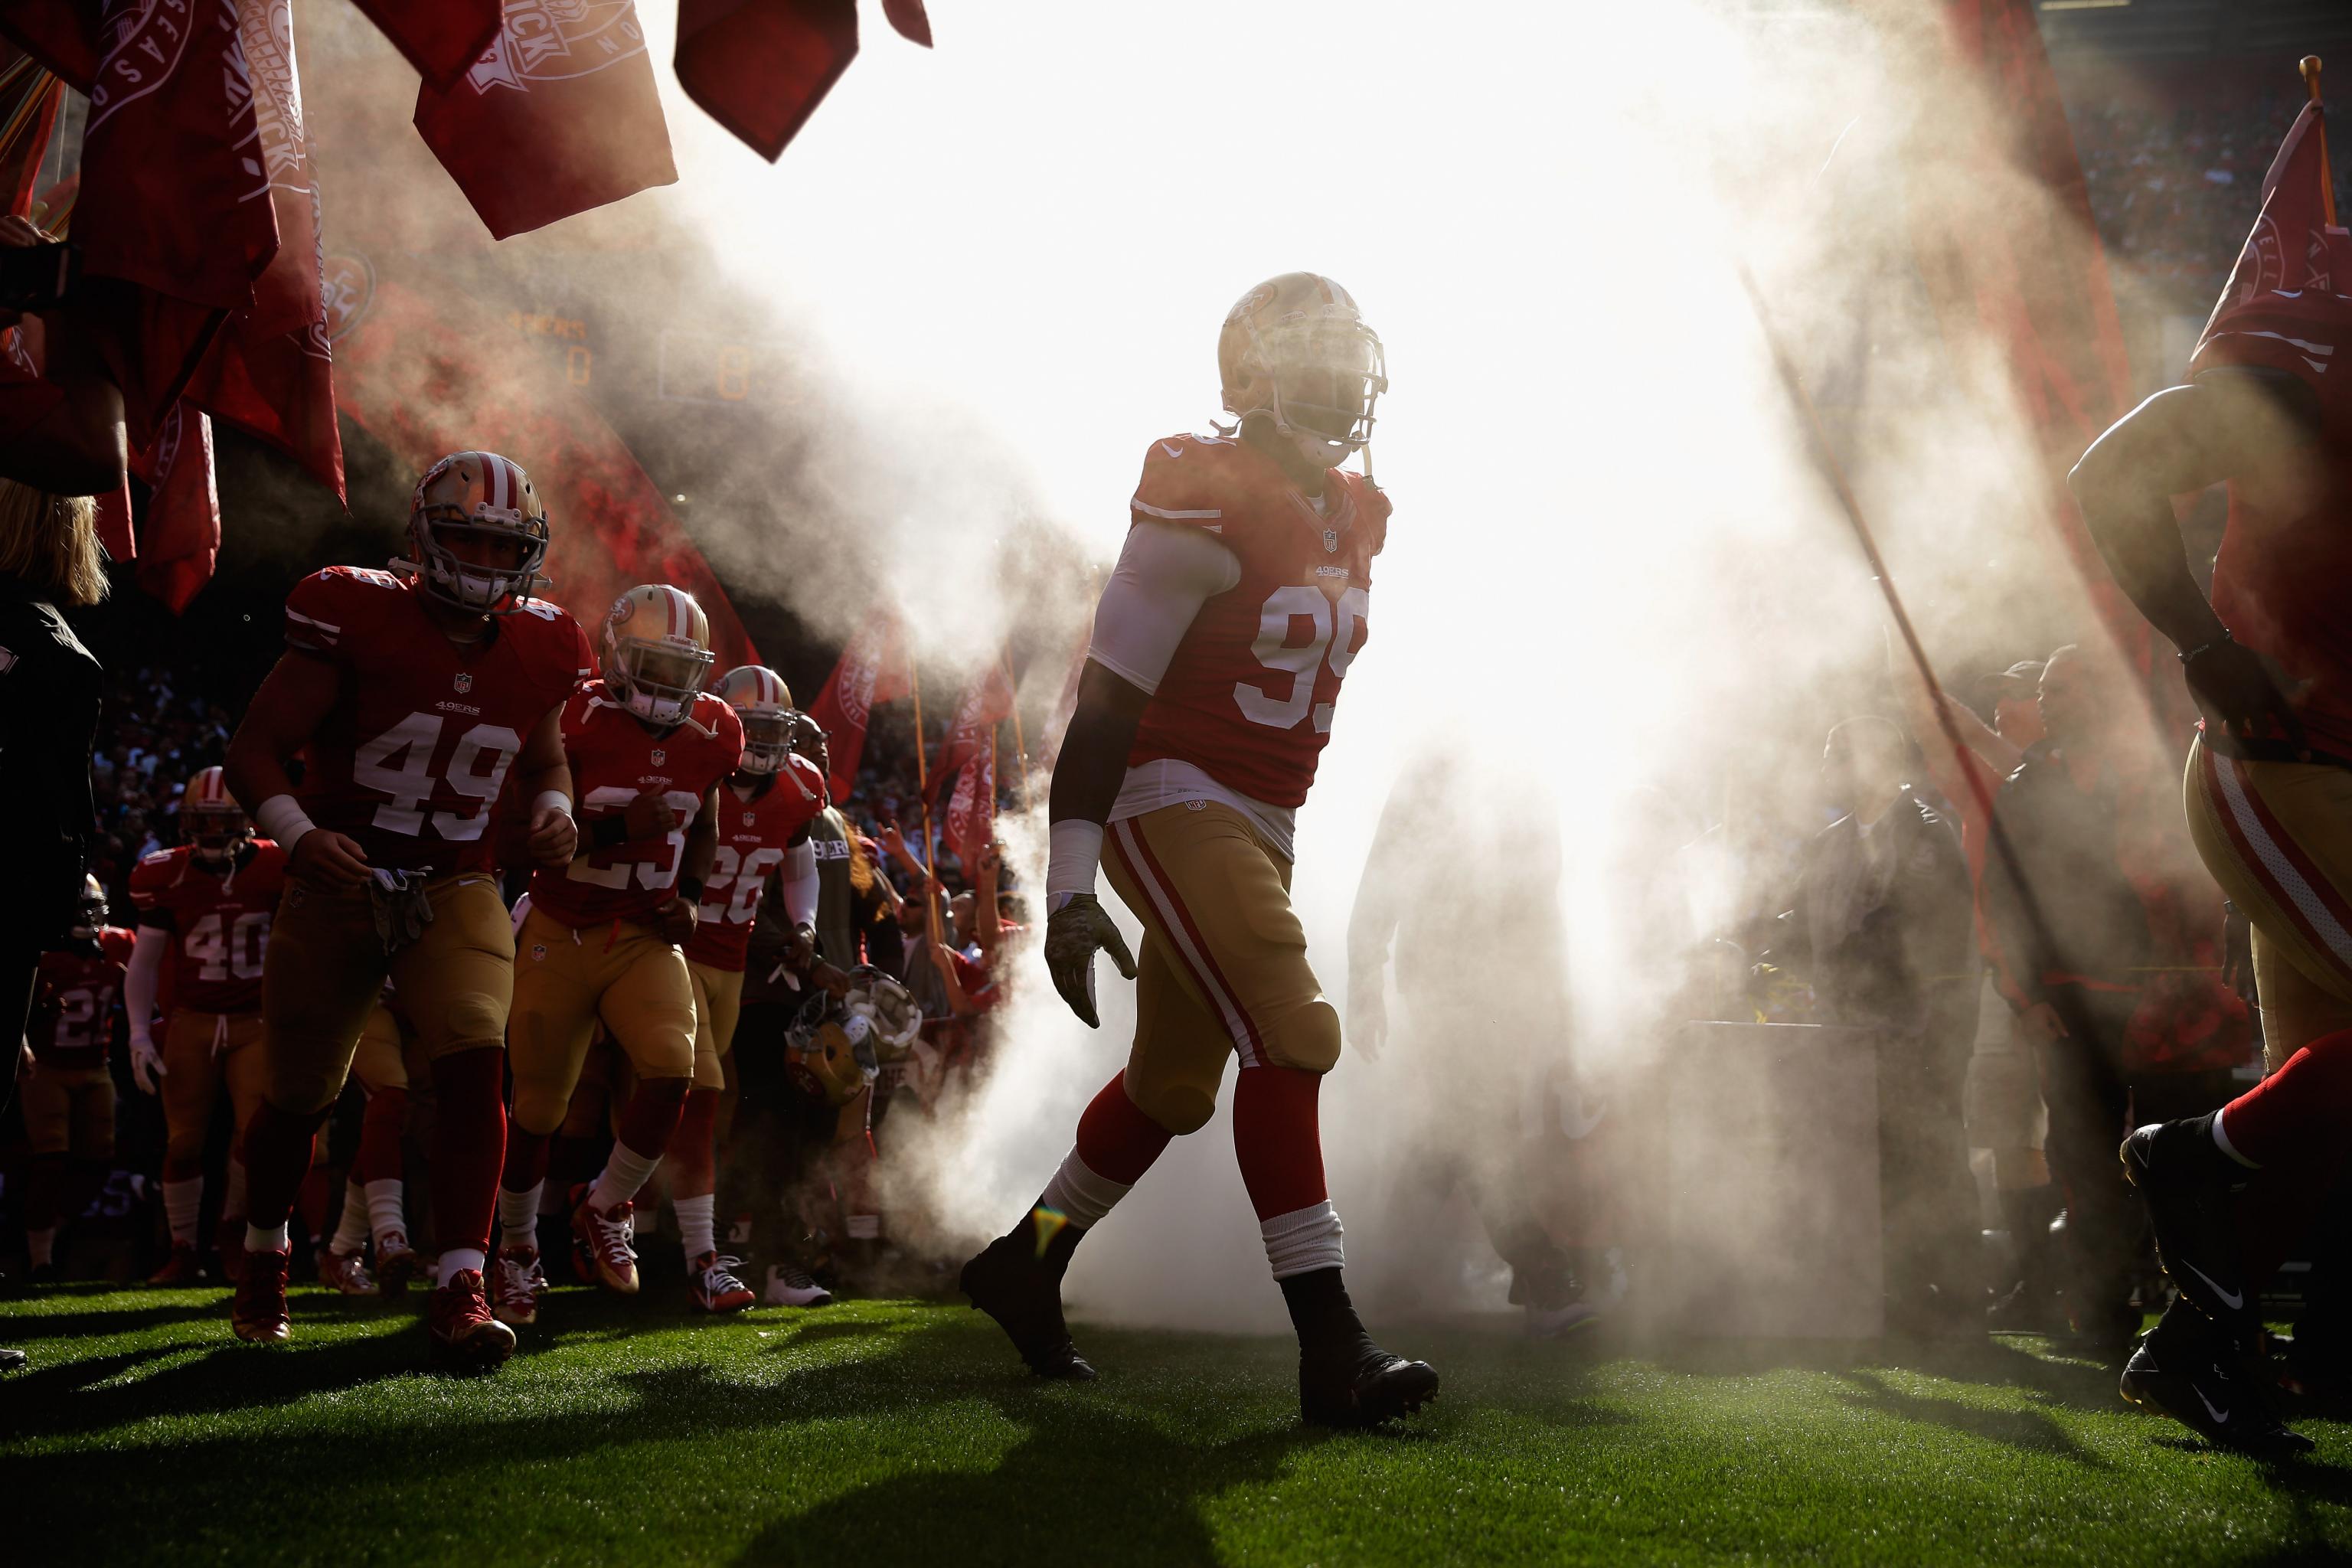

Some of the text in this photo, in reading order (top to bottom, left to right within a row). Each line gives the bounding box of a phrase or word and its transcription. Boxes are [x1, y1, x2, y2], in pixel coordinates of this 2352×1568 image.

[1315, 566, 1349, 580] 49ERS
[435, 701, 482, 717] 49ERS
[352, 711, 521, 841] 49
[637, 775, 675, 786] 49ERS
[566, 786, 701, 891] 23
[697, 844, 785, 925] 26
[184, 911, 271, 982] 40
